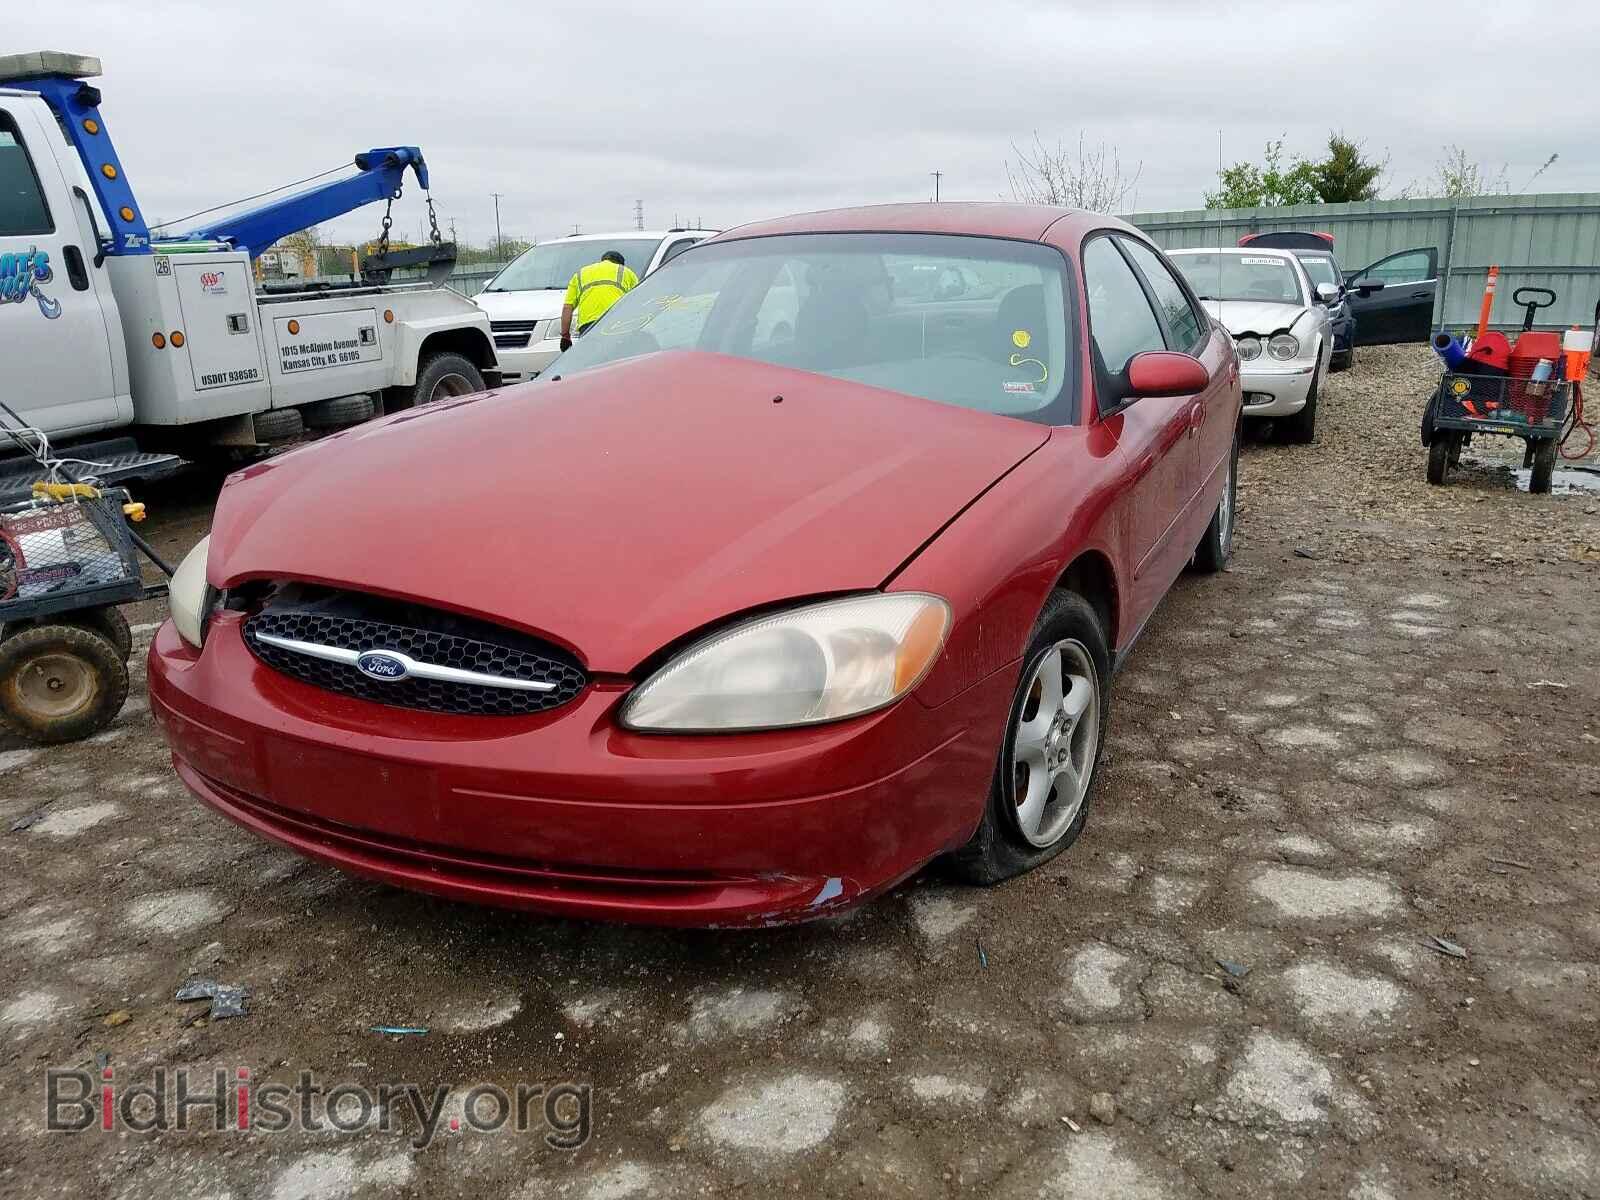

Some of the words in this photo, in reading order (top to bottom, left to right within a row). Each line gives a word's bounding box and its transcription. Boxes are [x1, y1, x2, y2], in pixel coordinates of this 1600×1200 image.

[156, 261, 170, 274] 26
[281, 345, 299, 357] 1015
[300, 341, 333, 355] McAlpine
[333, 339, 359, 350] Avenue
[282, 359, 311, 370] Kansas
[327, 353, 337, 364] KS
[338, 350, 360, 363] 66105
[201, 372, 227, 386] USDOT
[368, 656, 398, 676] Ford
